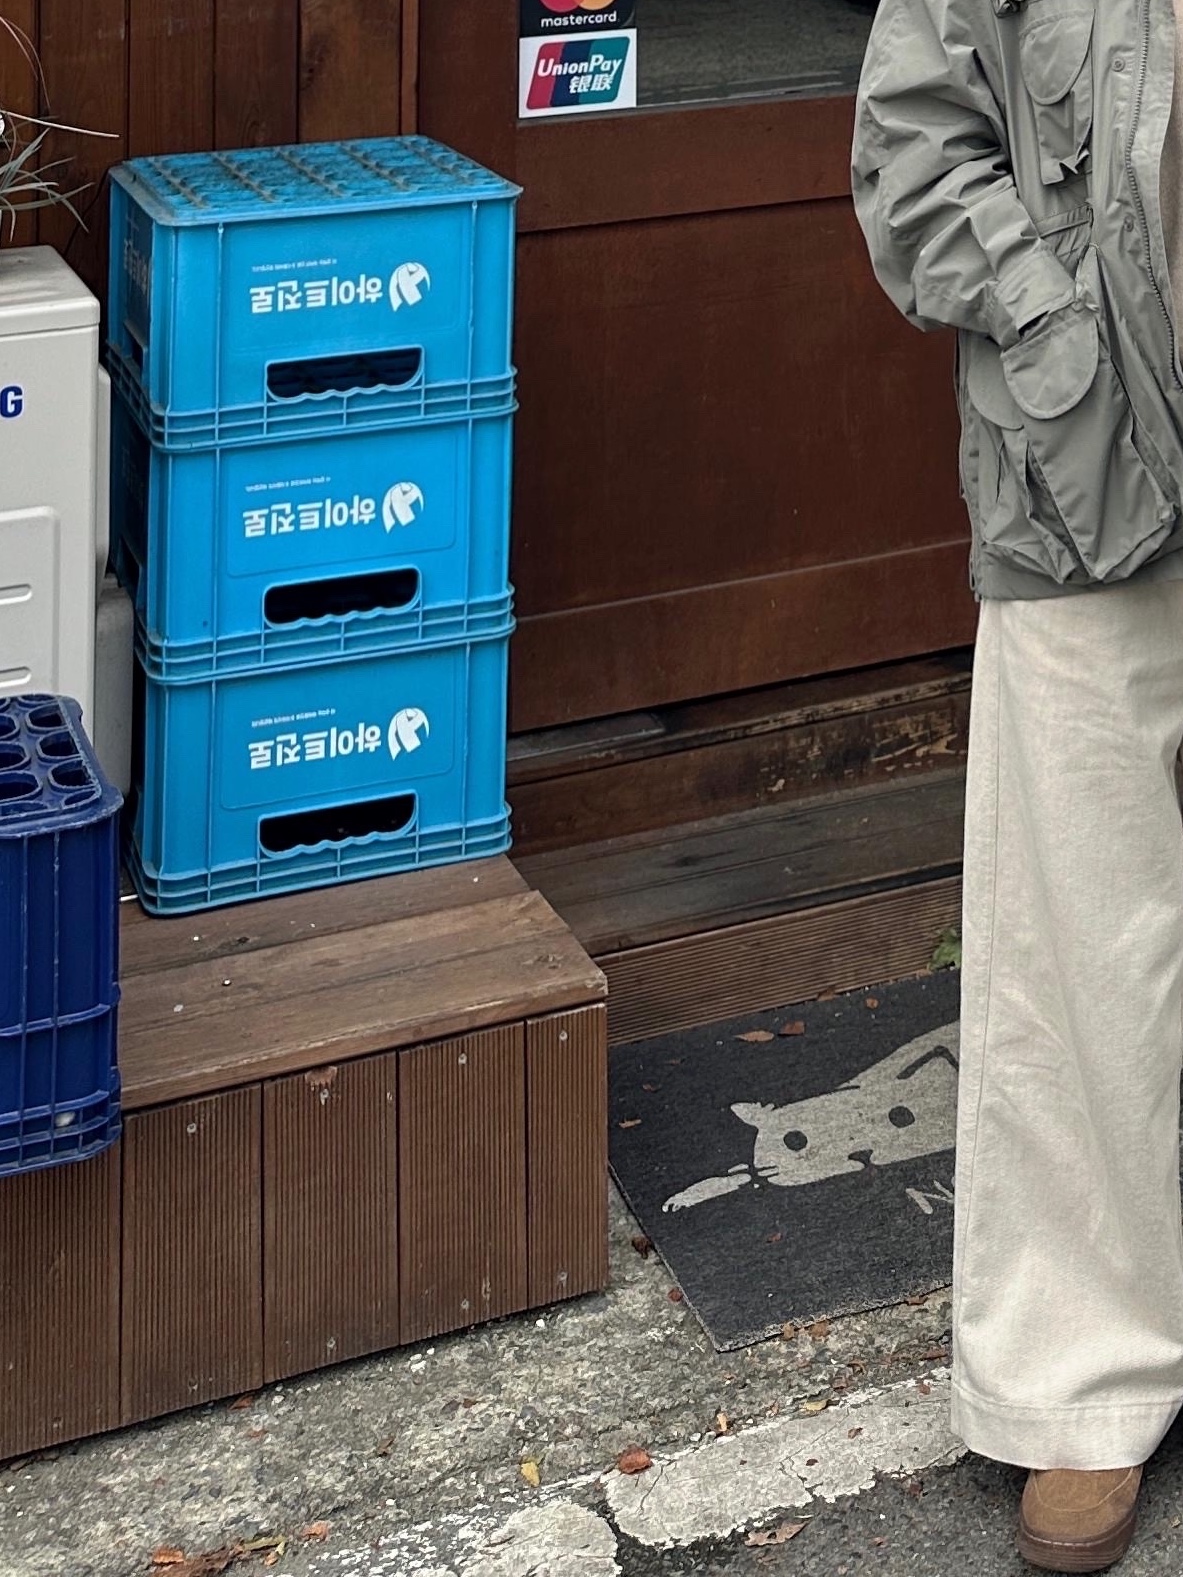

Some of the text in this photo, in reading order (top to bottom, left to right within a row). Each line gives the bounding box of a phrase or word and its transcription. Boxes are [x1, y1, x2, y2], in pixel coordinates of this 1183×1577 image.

[541, 11, 617, 28] mastercard
[537, 54, 622, 78] UnionPay
[569, 74, 613, 94] 银联
[249, 273, 383, 314] 하이트진로
[242, 494, 377, 538] 하이트진로
[247, 722, 382, 770] 하이트진로
